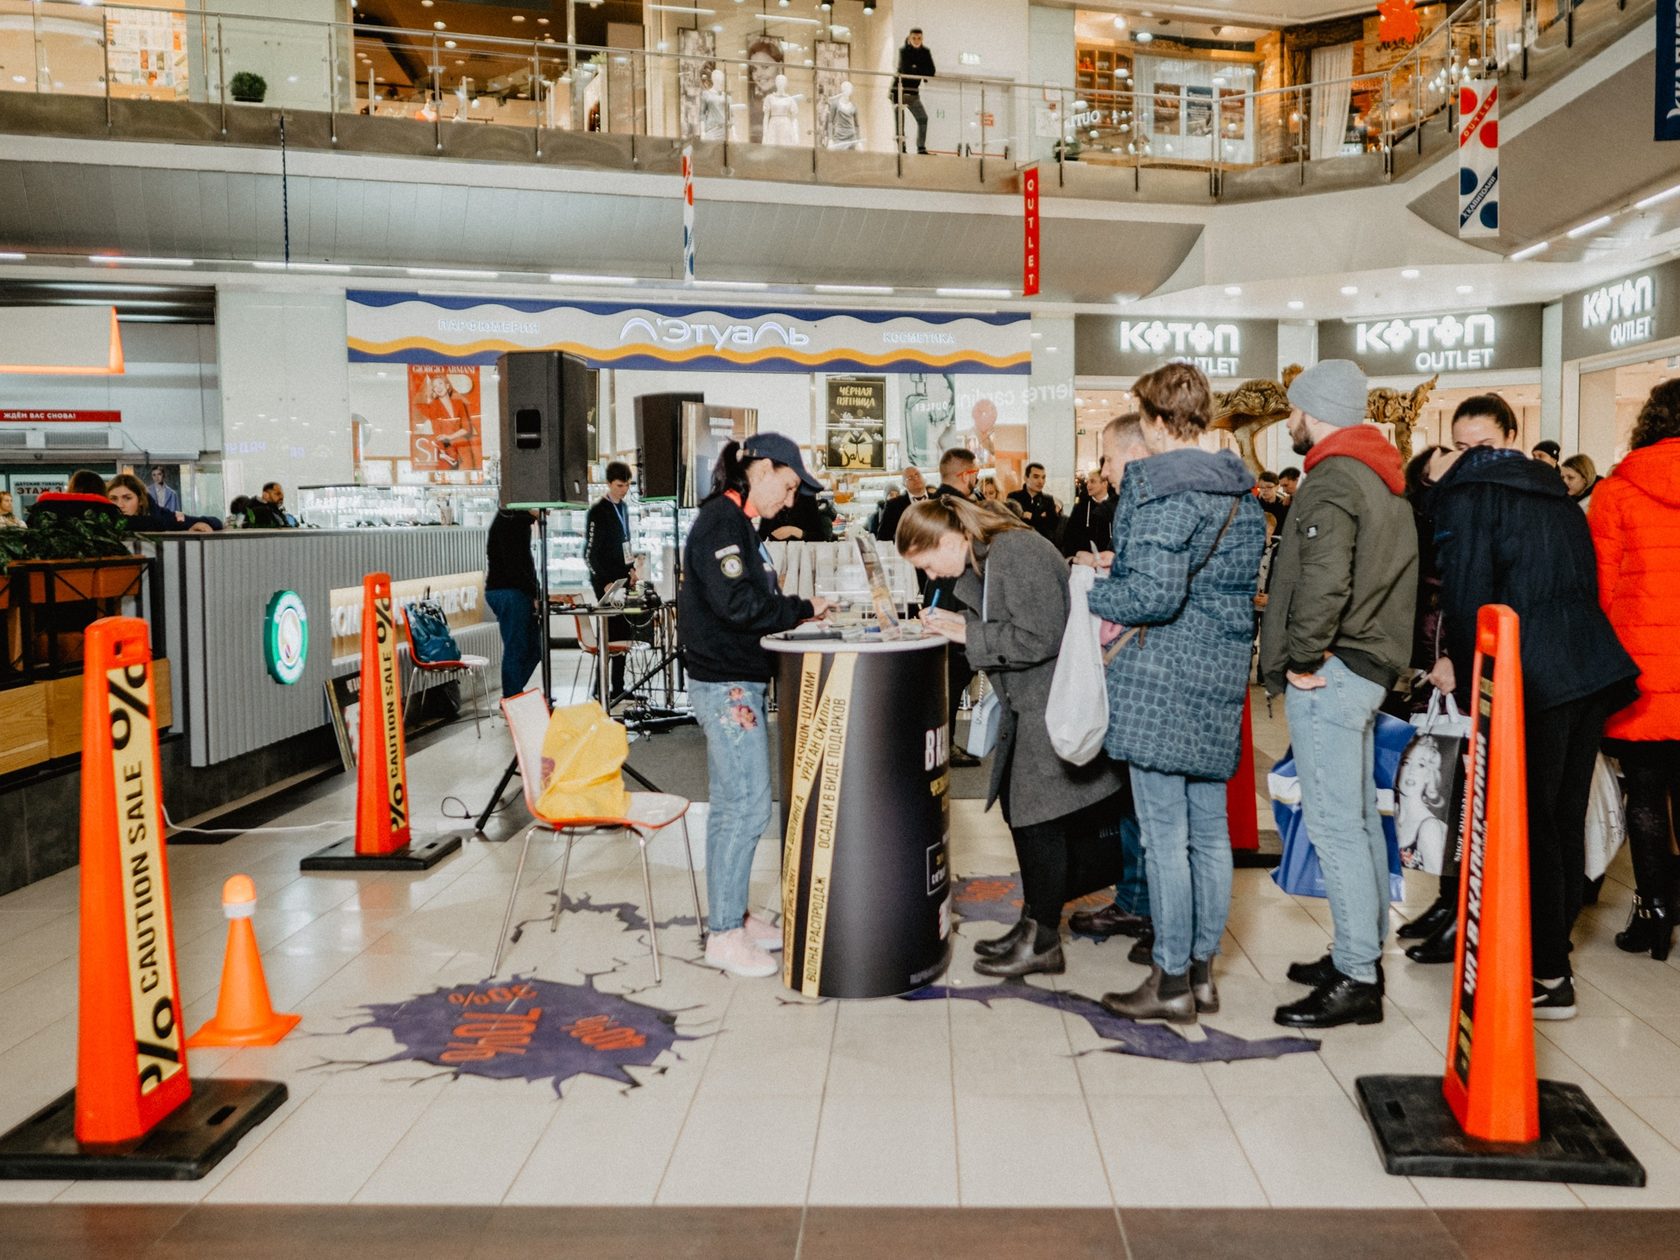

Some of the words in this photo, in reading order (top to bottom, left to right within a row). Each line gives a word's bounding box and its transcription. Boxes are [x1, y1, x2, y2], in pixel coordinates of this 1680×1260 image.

[1463, 95, 1494, 138] OUTLET
[1026, 178, 1035, 287] OUTLET
[1582, 275, 1652, 329] KOTON
[437, 318, 540, 335] ПАРФЮМЕРИЯ
[882, 331, 956, 345] КОСМЕТИКА
[1119, 320, 1240, 353] KOTON
[1356, 313, 1495, 352] KOTON
[1610, 316, 1652, 347] OUTLET
[412, 365, 445, 375] GIORGIO
[447, 365, 476, 375] ARMANI
[1414, 347, 1494, 371] OUTLET
[46, 412, 77, 420] СНОВА!
[836, 396, 876, 408] ПЯТНИЦА
[382, 651, 394, 697] SALE
[384, 700, 402, 779] CAUTION
[826, 697, 847, 759] ПОДАРКОВ
[823, 760, 840, 792] ВИДЕ
[123, 760, 145, 842] SALE
[822, 793, 836, 801] В
[817, 803, 835, 849] ОСАДКИ
[129, 851, 161, 996] CAUTION
[808, 876, 827, 943] РАСПРОДАЖ
[806, 946, 820, 983] ВОЛНА
